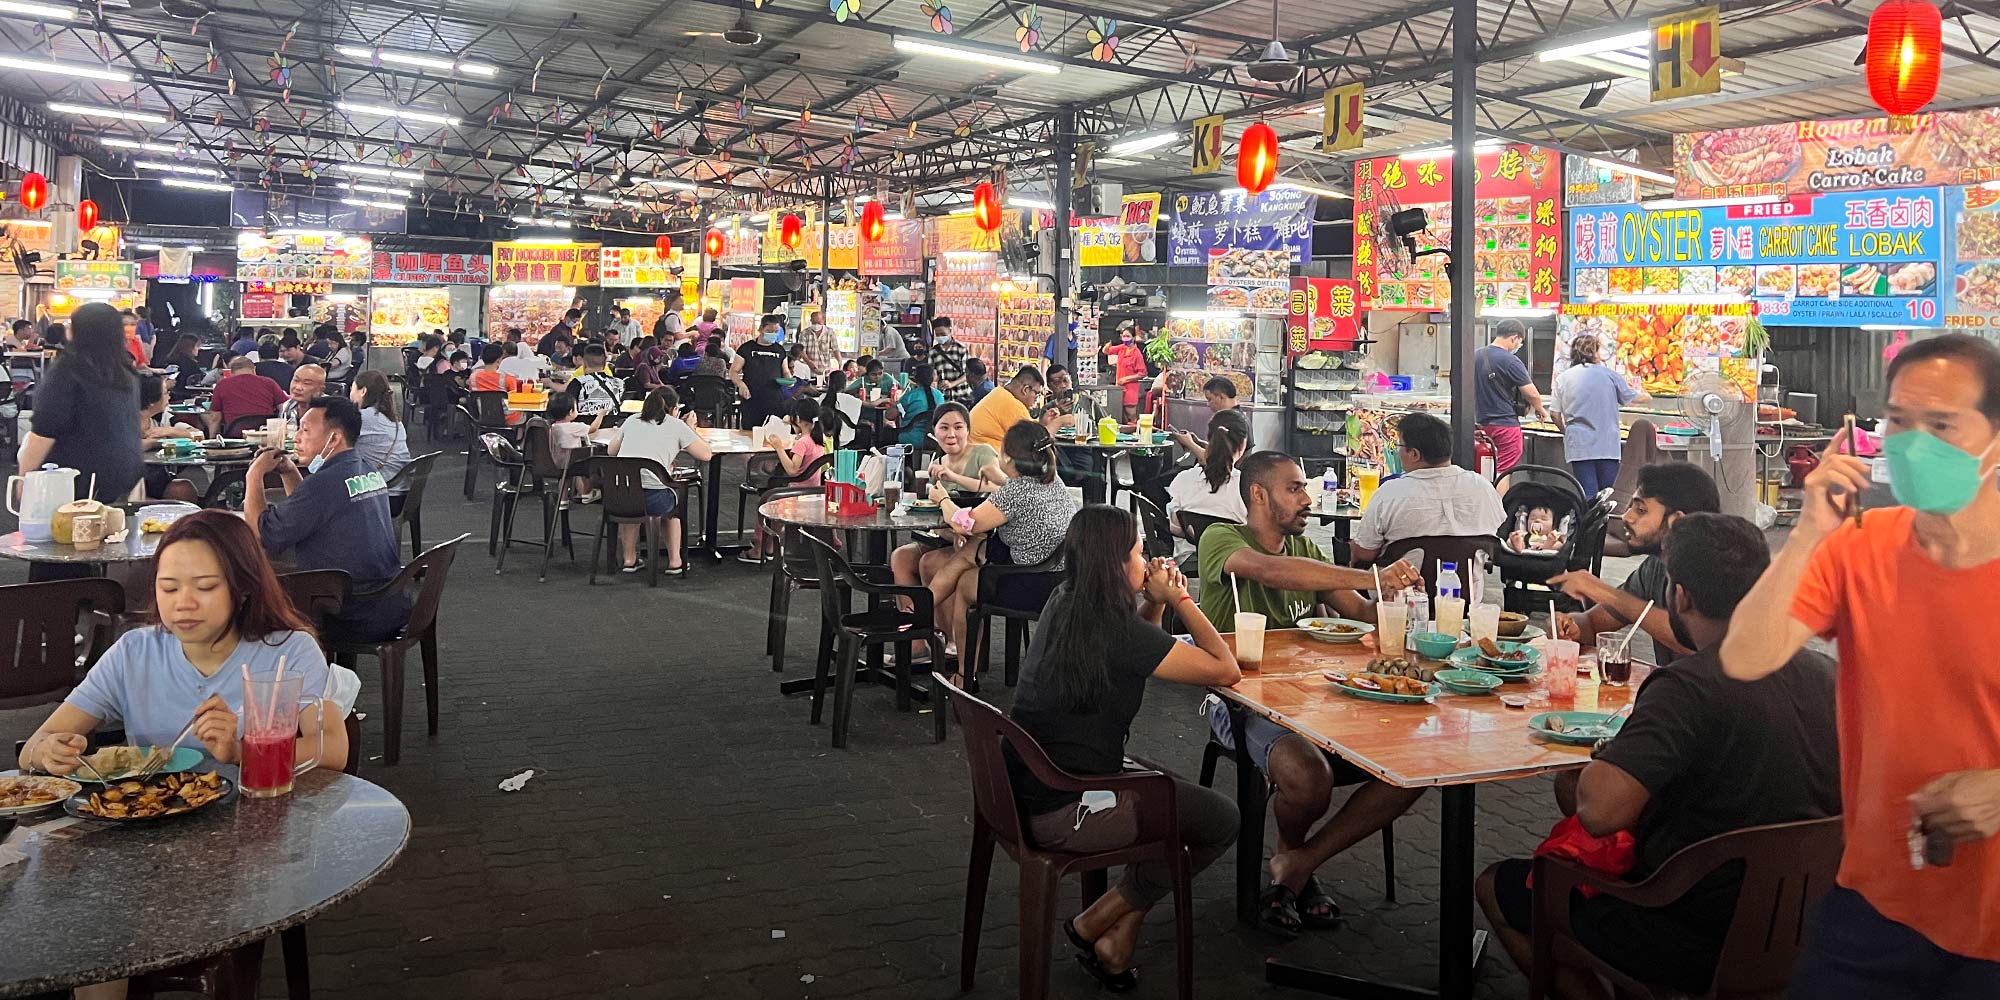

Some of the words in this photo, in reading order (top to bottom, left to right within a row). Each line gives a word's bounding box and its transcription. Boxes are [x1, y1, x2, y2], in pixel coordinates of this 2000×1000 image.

[1652, 22, 1681, 92] H
[1327, 94, 1340, 146] J
[1798, 112, 1934, 139] Homeme
[1193, 126, 1211, 168] K
[1827, 144, 1895, 168] Lobak
[1809, 169, 1871, 189] Carrot
[1873, 166, 1926, 185] Cake
[1126, 200, 1153, 225] RICE
[1743, 203, 1794, 216] FRIED
[1845, 197, 1934, 229] 五香卤肉
[1080, 232, 1121, 246] 喱鸡饭
[1213, 218, 1263, 245] 萝卜糕
[1622, 209, 1703, 263] OYSTER
[1710, 226, 1753, 260] 萝卜糕
[1759, 225, 1804, 257] CARROT
[1806, 224, 1838, 256] CAKE
[1850, 230, 1924, 257] LOBAK
[396, 252, 489, 274] 咖喱鱼头
[497, 247, 513, 261] FRY
[557, 248, 575, 261] MEE
[394, 273, 431, 283] CURRY
[434, 273, 457, 284] FISH
[459, 274, 489, 284] HEAD
[495, 263, 563, 282] 炒福建面
[1228, 278, 1255, 286] OYSTERS
[1562, 303, 1592, 316] PENANG
[1594, 303, 1617, 316] FRIED
[1619, 303, 1650, 316] OYSTER
[1655, 303, 1689, 316] CARROT
[1691, 303, 1715, 316] CAKE
[1854, 300, 1893, 308] ADDITIONAL
[1907, 299, 1935, 320] 10
[1291, 290, 1306, 351] 冒菜
[1945, 315, 1985, 327] FRIED
